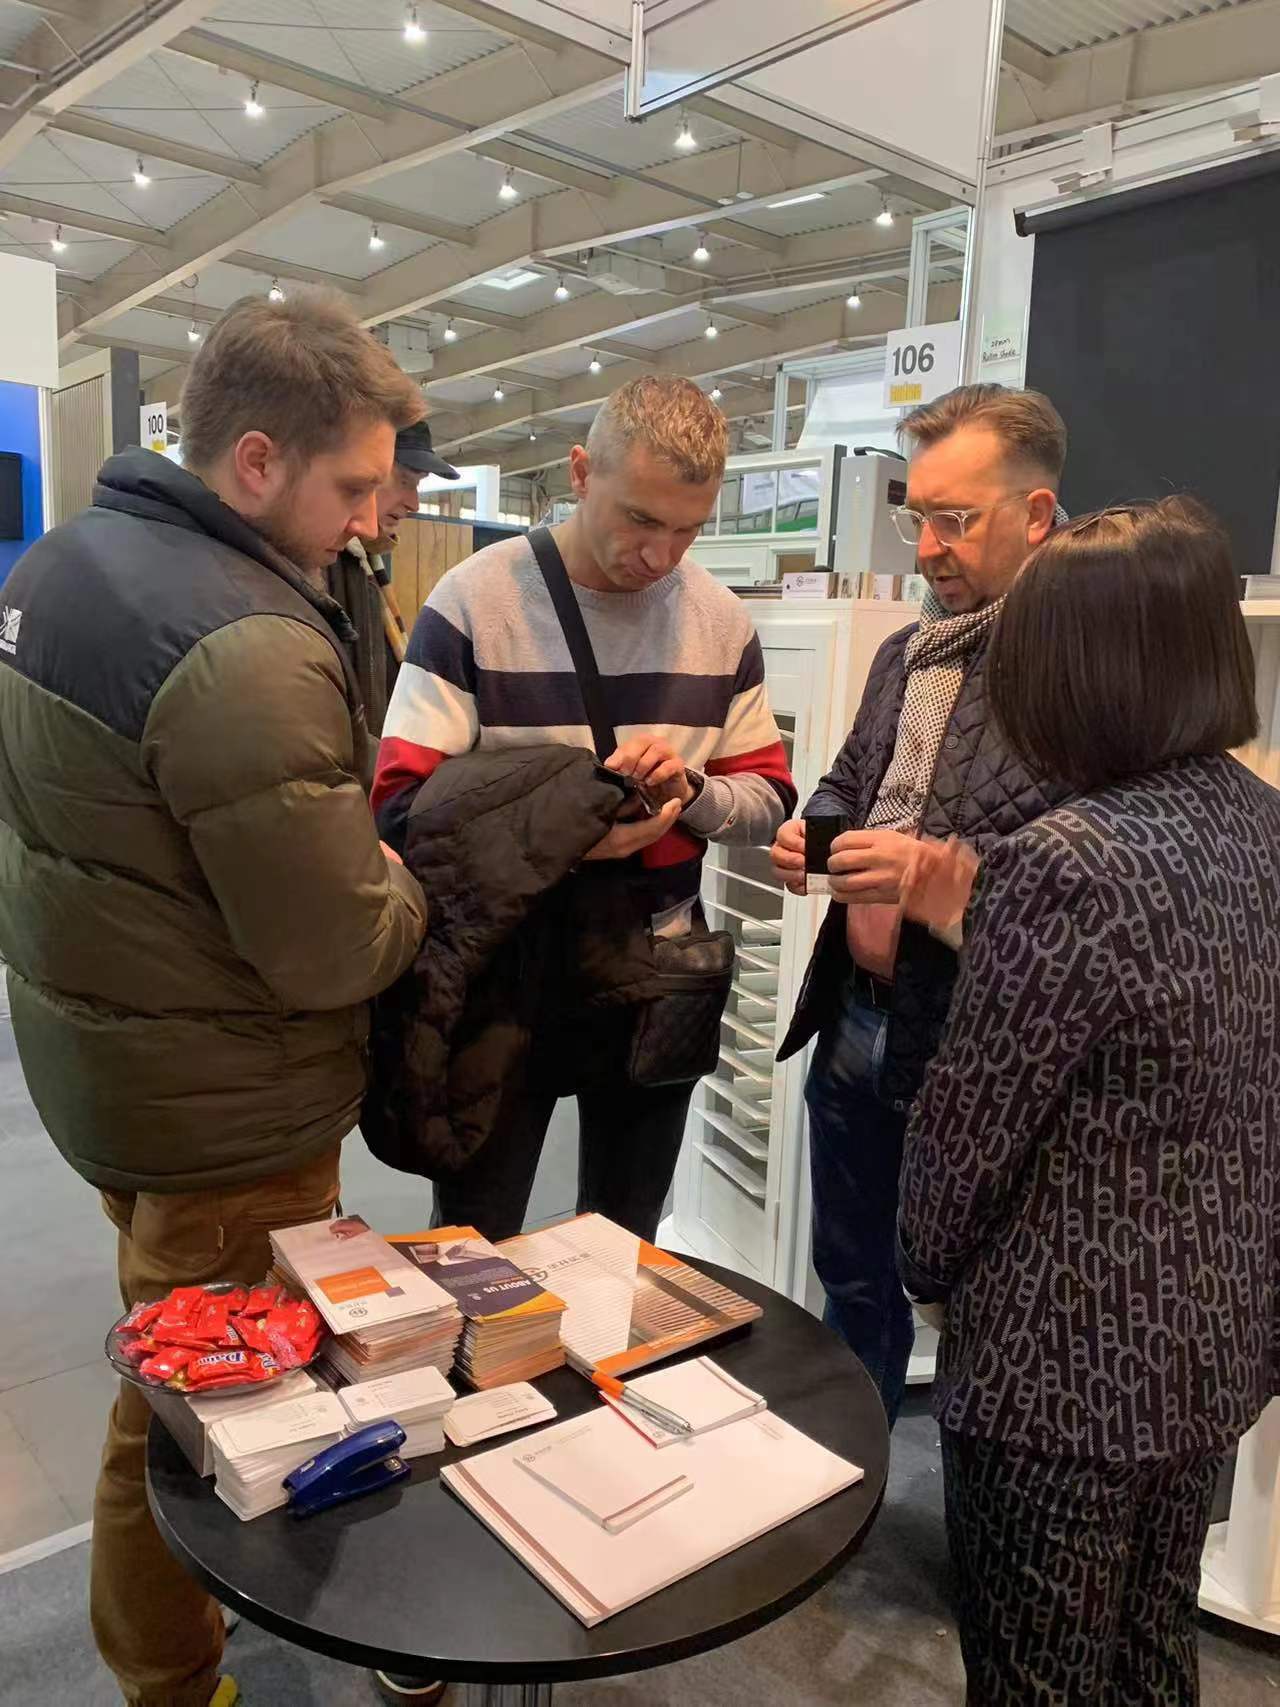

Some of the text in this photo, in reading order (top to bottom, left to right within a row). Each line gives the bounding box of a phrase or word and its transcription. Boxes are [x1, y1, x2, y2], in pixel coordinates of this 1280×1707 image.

[893, 342, 935, 376] 106
[148, 414, 164, 435] 100
[483, 1279, 531, 1293] ABOUT US
[199, 1351, 243, 1365] Daim
